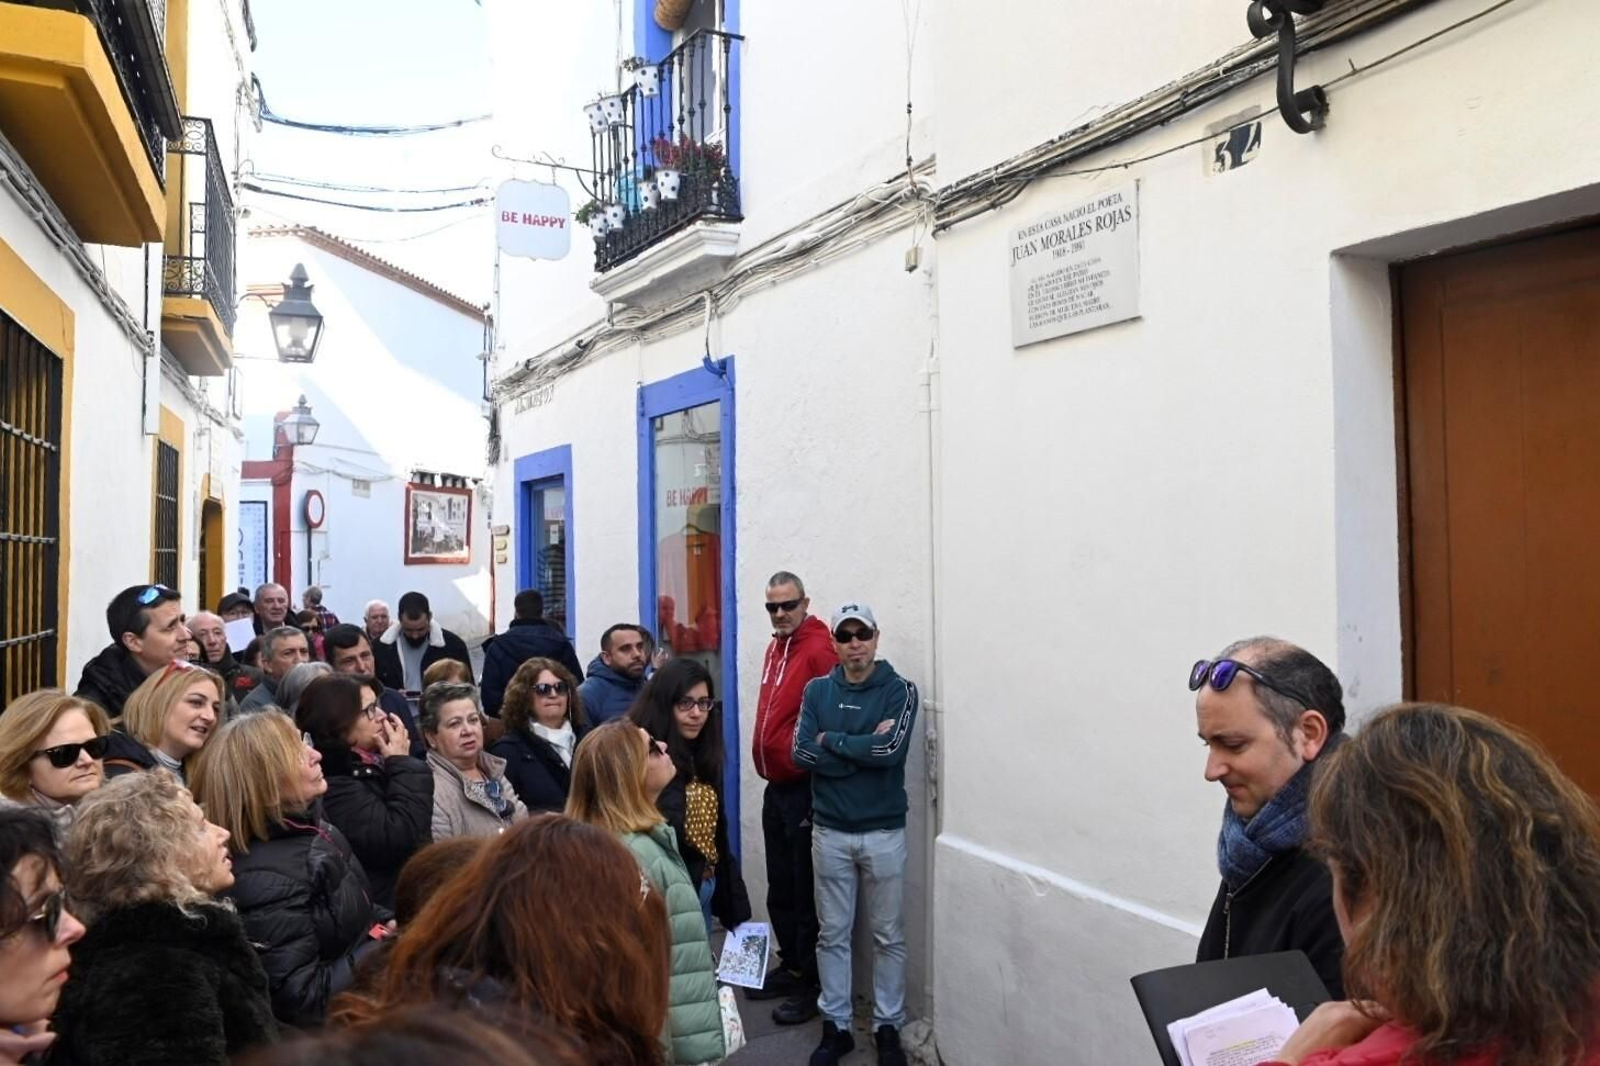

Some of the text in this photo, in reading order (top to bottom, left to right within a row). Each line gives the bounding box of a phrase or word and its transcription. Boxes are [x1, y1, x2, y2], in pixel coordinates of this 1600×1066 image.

[501, 211, 566, 229] BE HAPPY
[1028, 223, 1044, 236] ESTA
[1045, 217, 1062, 230] CASA
[1087, 202, 1096, 214] EL
[1098, 193, 1123, 210] POETA
[1010, 205, 1132, 267] JUAN MORALES ROJAS
[667, 489, 677, 508] BE
